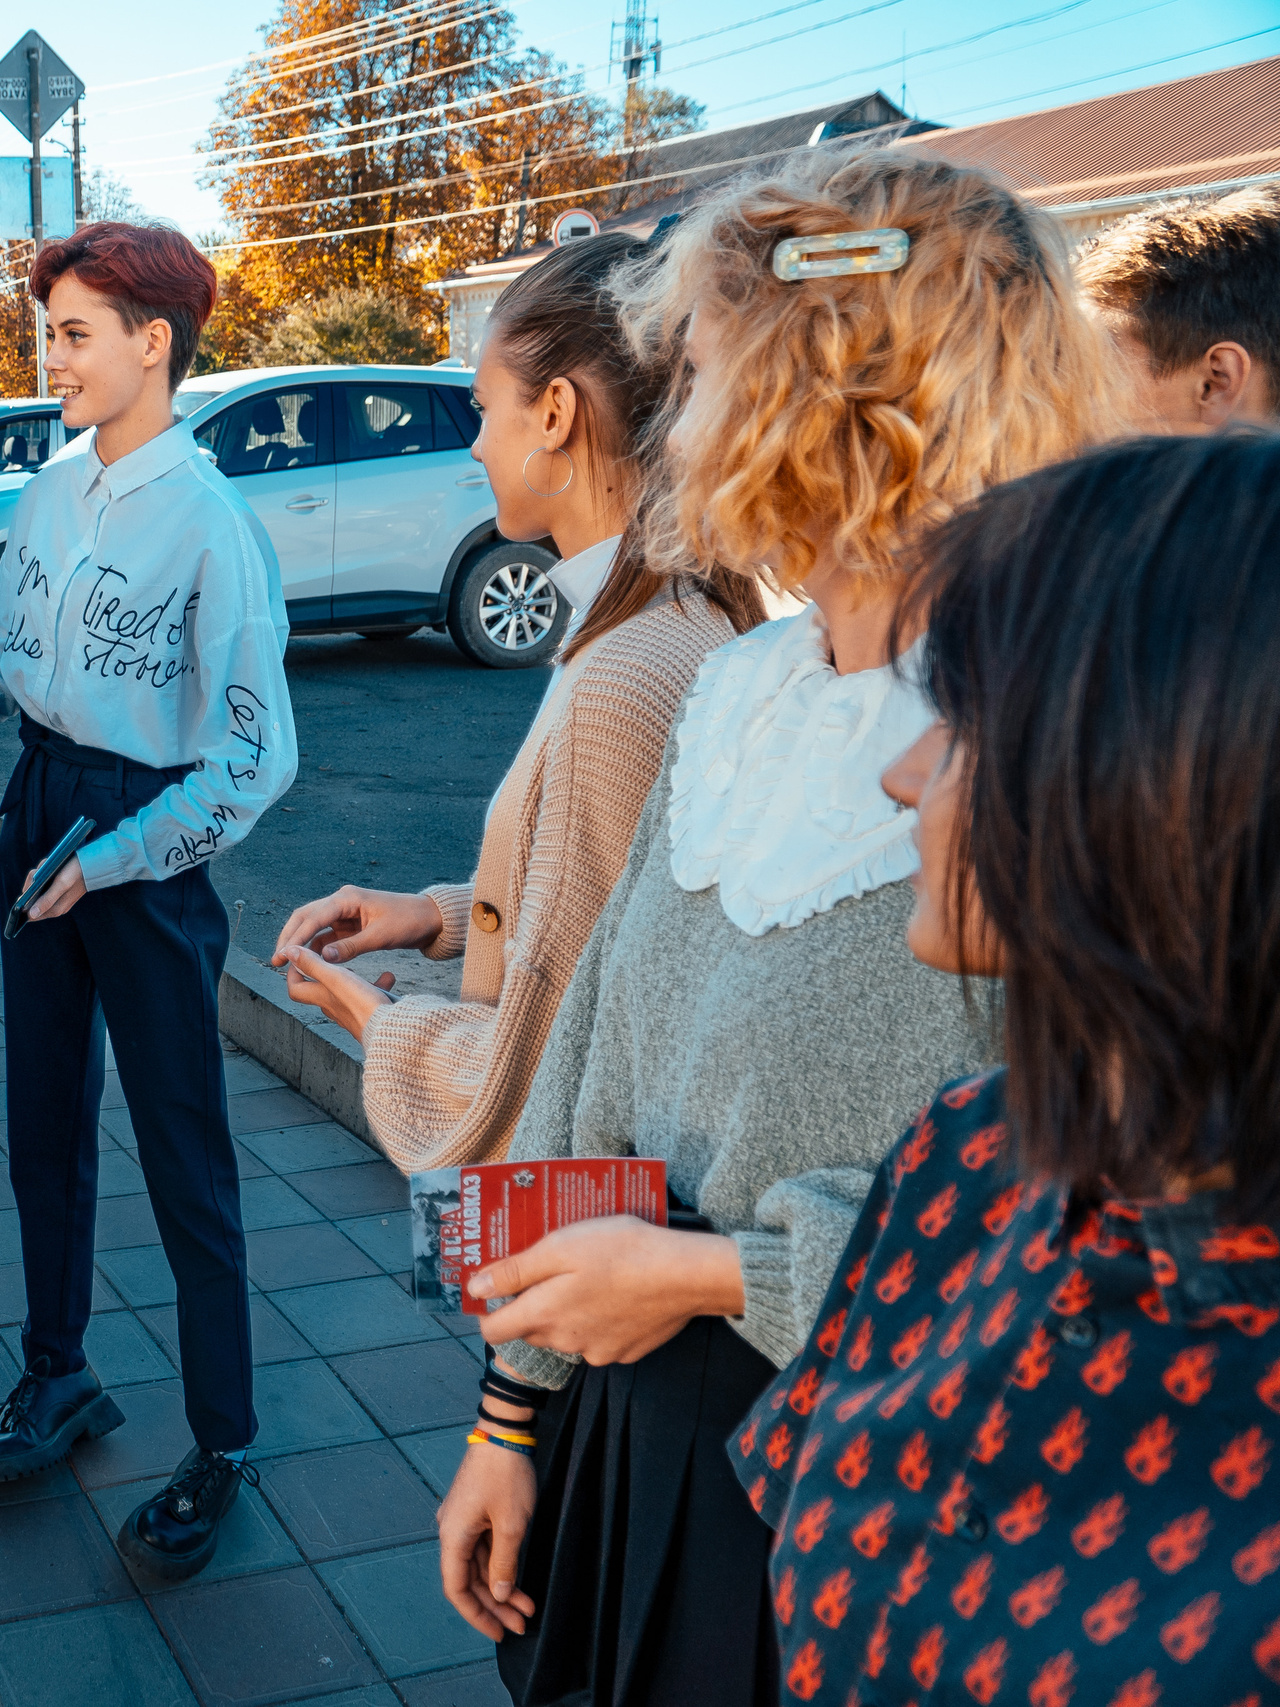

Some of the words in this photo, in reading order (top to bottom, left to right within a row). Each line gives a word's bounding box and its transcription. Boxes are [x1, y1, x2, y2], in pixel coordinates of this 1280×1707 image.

[462, 1174, 482, 1241] КАВКАЗ
[439, 1207, 462, 1285] БИТВА
[463, 1243, 482, 1267] ЗА
